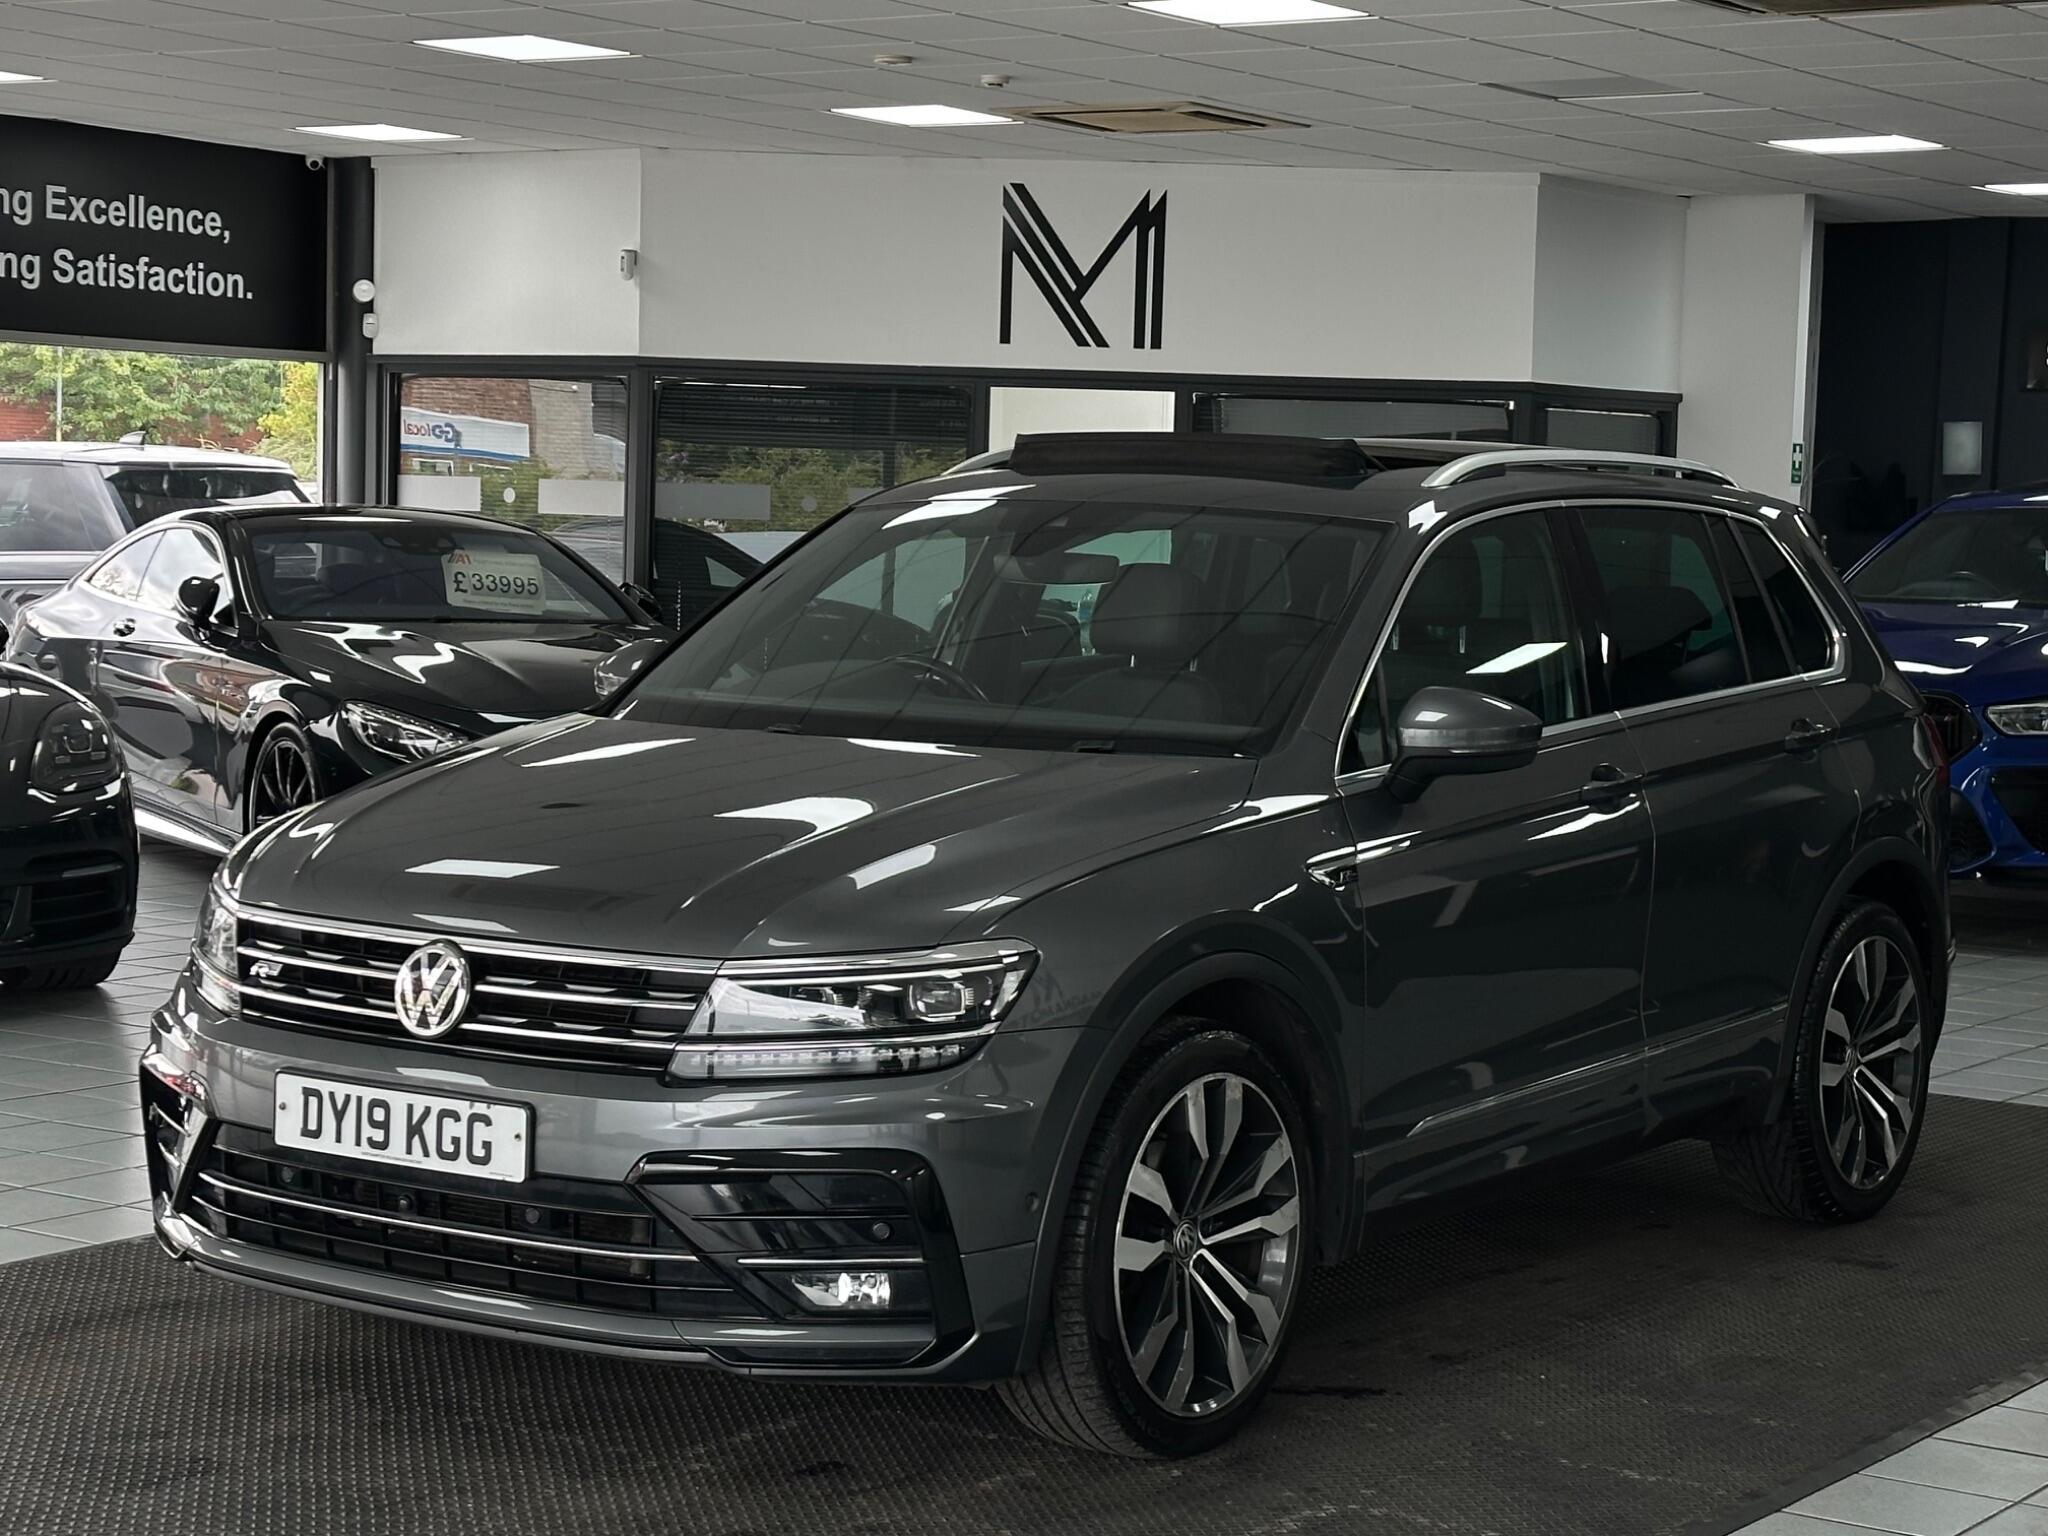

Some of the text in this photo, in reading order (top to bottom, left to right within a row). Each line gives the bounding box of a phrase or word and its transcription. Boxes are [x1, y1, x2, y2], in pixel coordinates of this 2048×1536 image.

[46, 184, 231, 244] Excellence,
[52, 248, 253, 299] Satisfaction.
[453, 571, 539, 595] £33995
[300, 1086, 493, 1166] DY19 KGG
